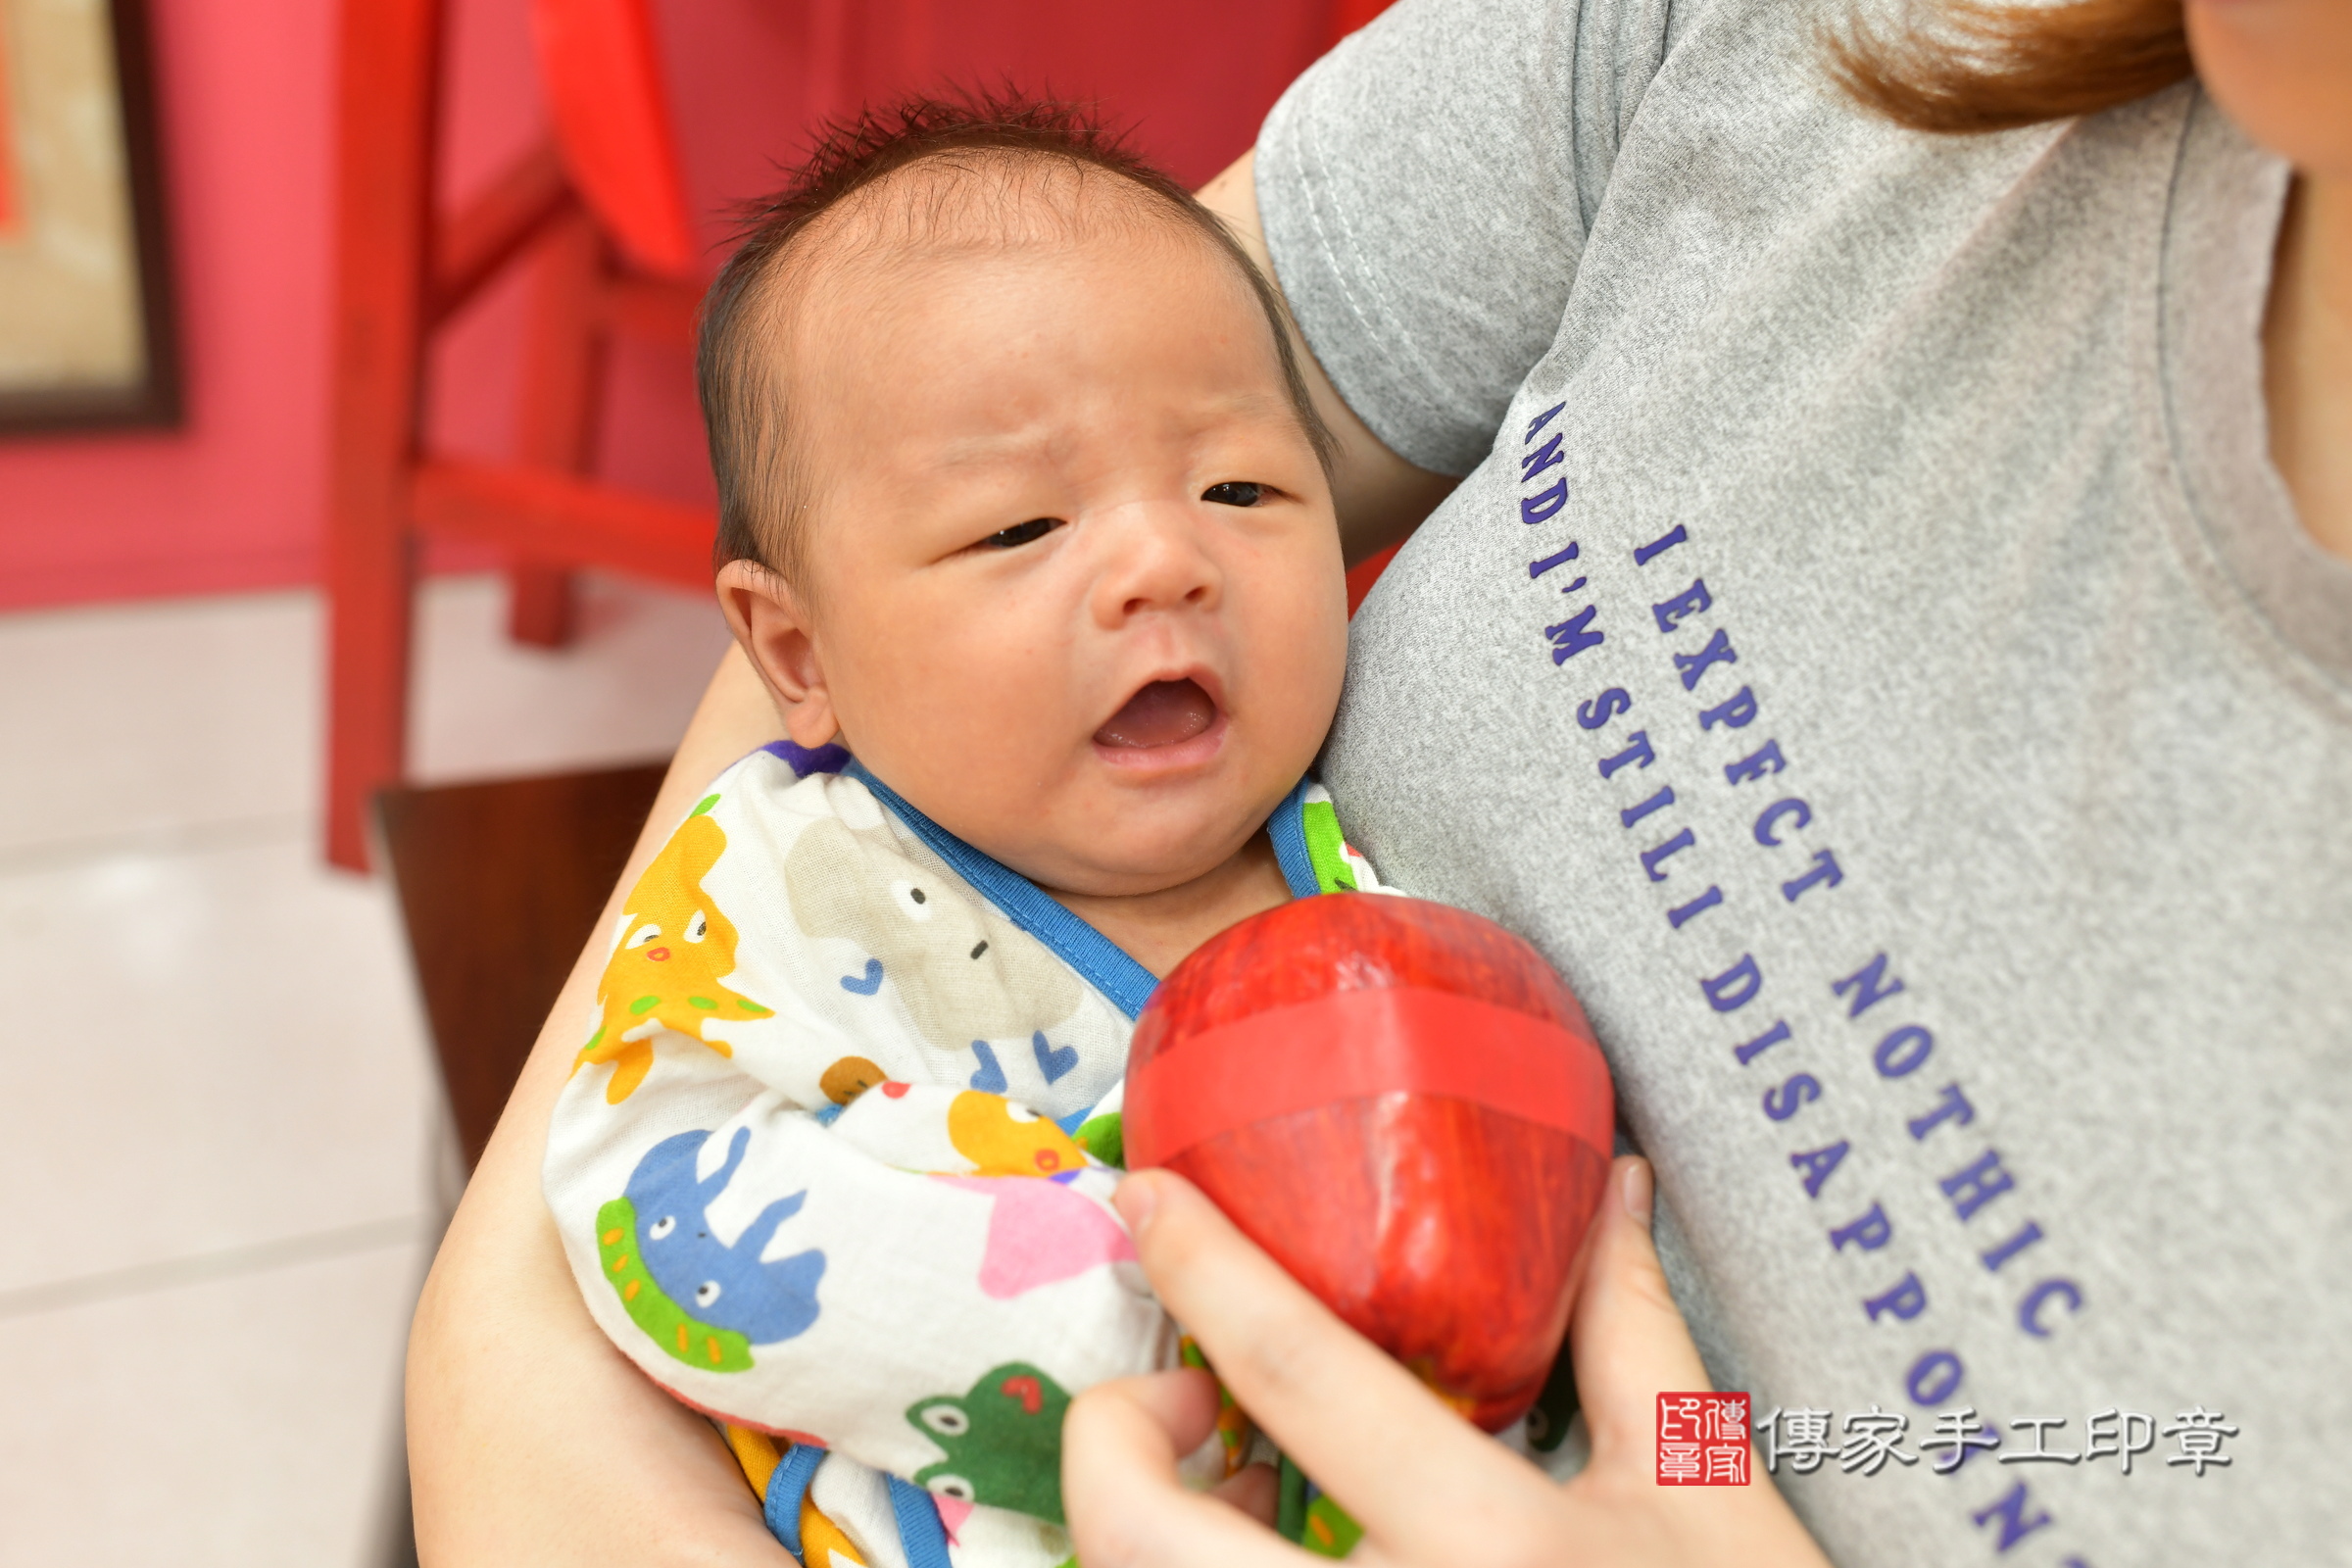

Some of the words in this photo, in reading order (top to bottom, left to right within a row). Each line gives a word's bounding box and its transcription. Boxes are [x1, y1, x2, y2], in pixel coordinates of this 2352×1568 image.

[1520, 400, 1569, 525] AND
[1529, 541, 1604, 666] I'M
[1634, 524, 1688, 566] I
[1699, 952, 2093, 1568] DISAPPOIN
